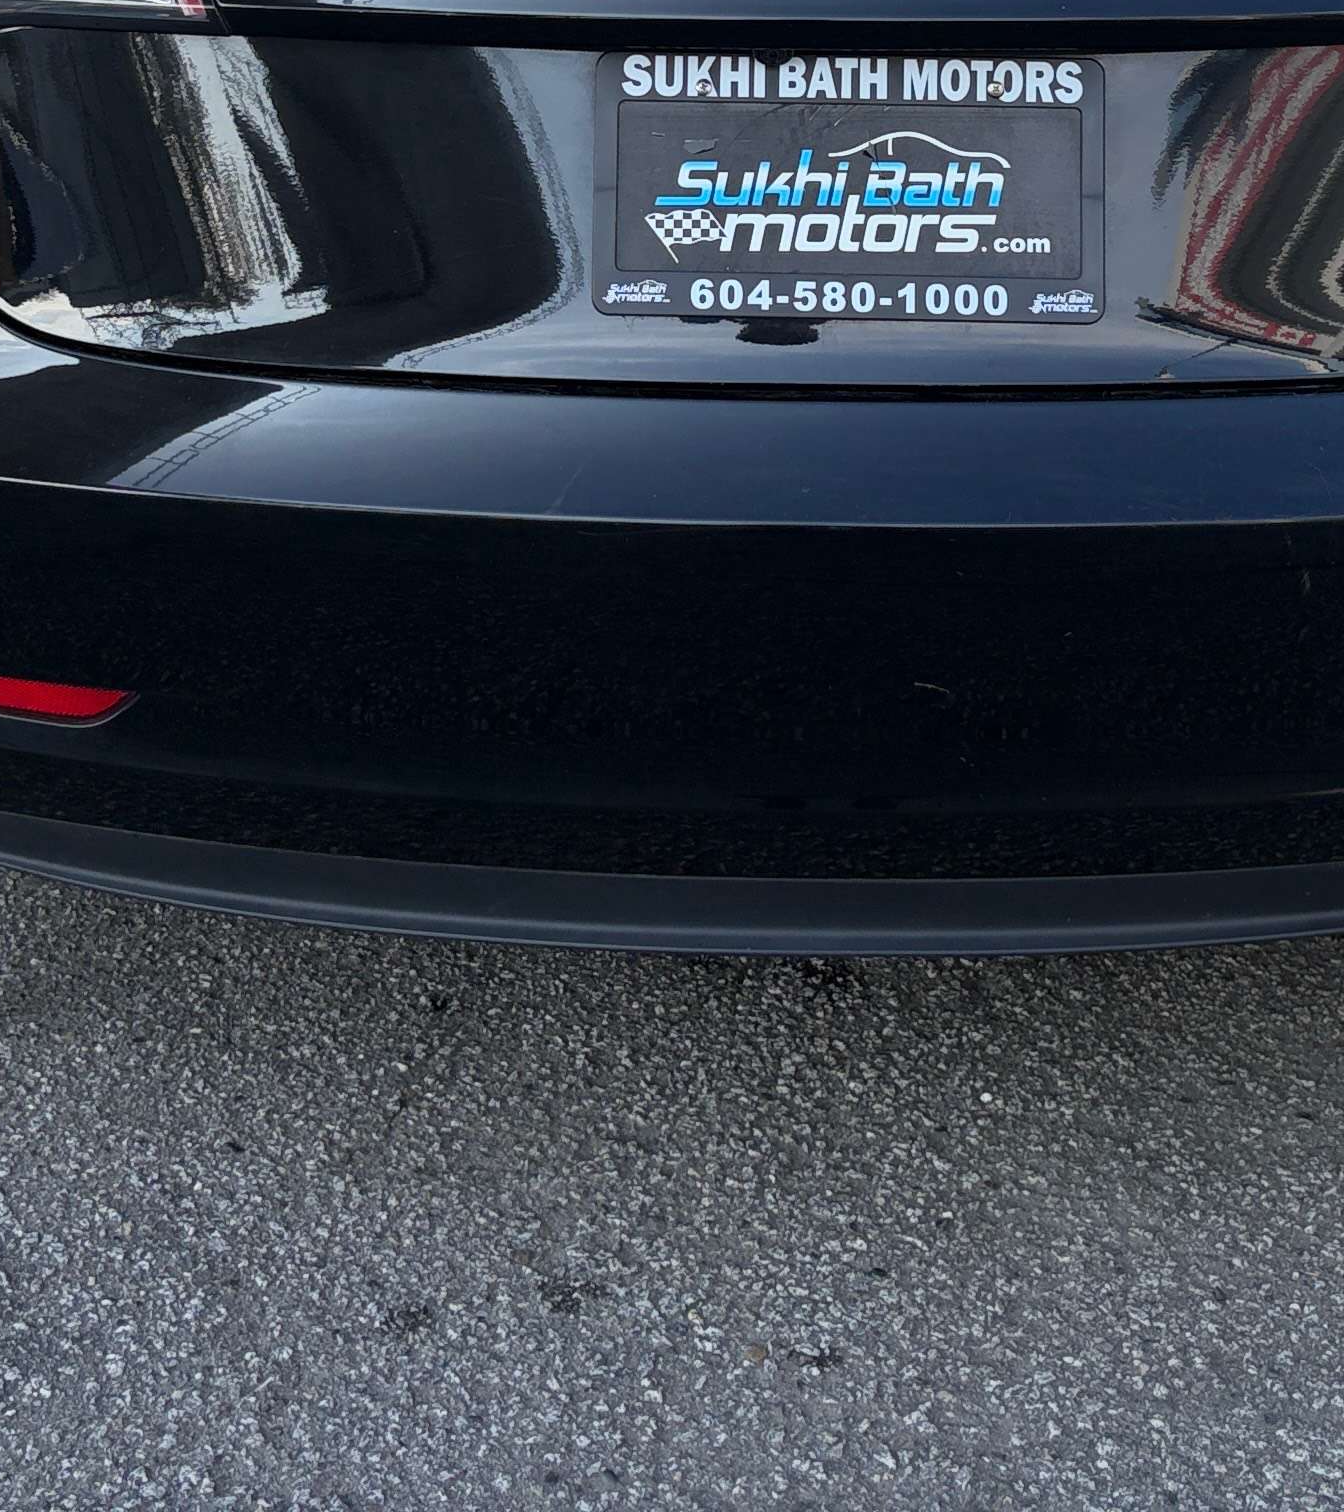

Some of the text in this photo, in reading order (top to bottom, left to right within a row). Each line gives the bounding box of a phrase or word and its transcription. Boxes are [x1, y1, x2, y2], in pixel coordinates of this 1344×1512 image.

[622, 54, 1084, 105] SUKHI BATH MOTORS
[655, 149, 1006, 208] Sukhi Bath
[689, 278, 1009, 317] 604-580-1000
